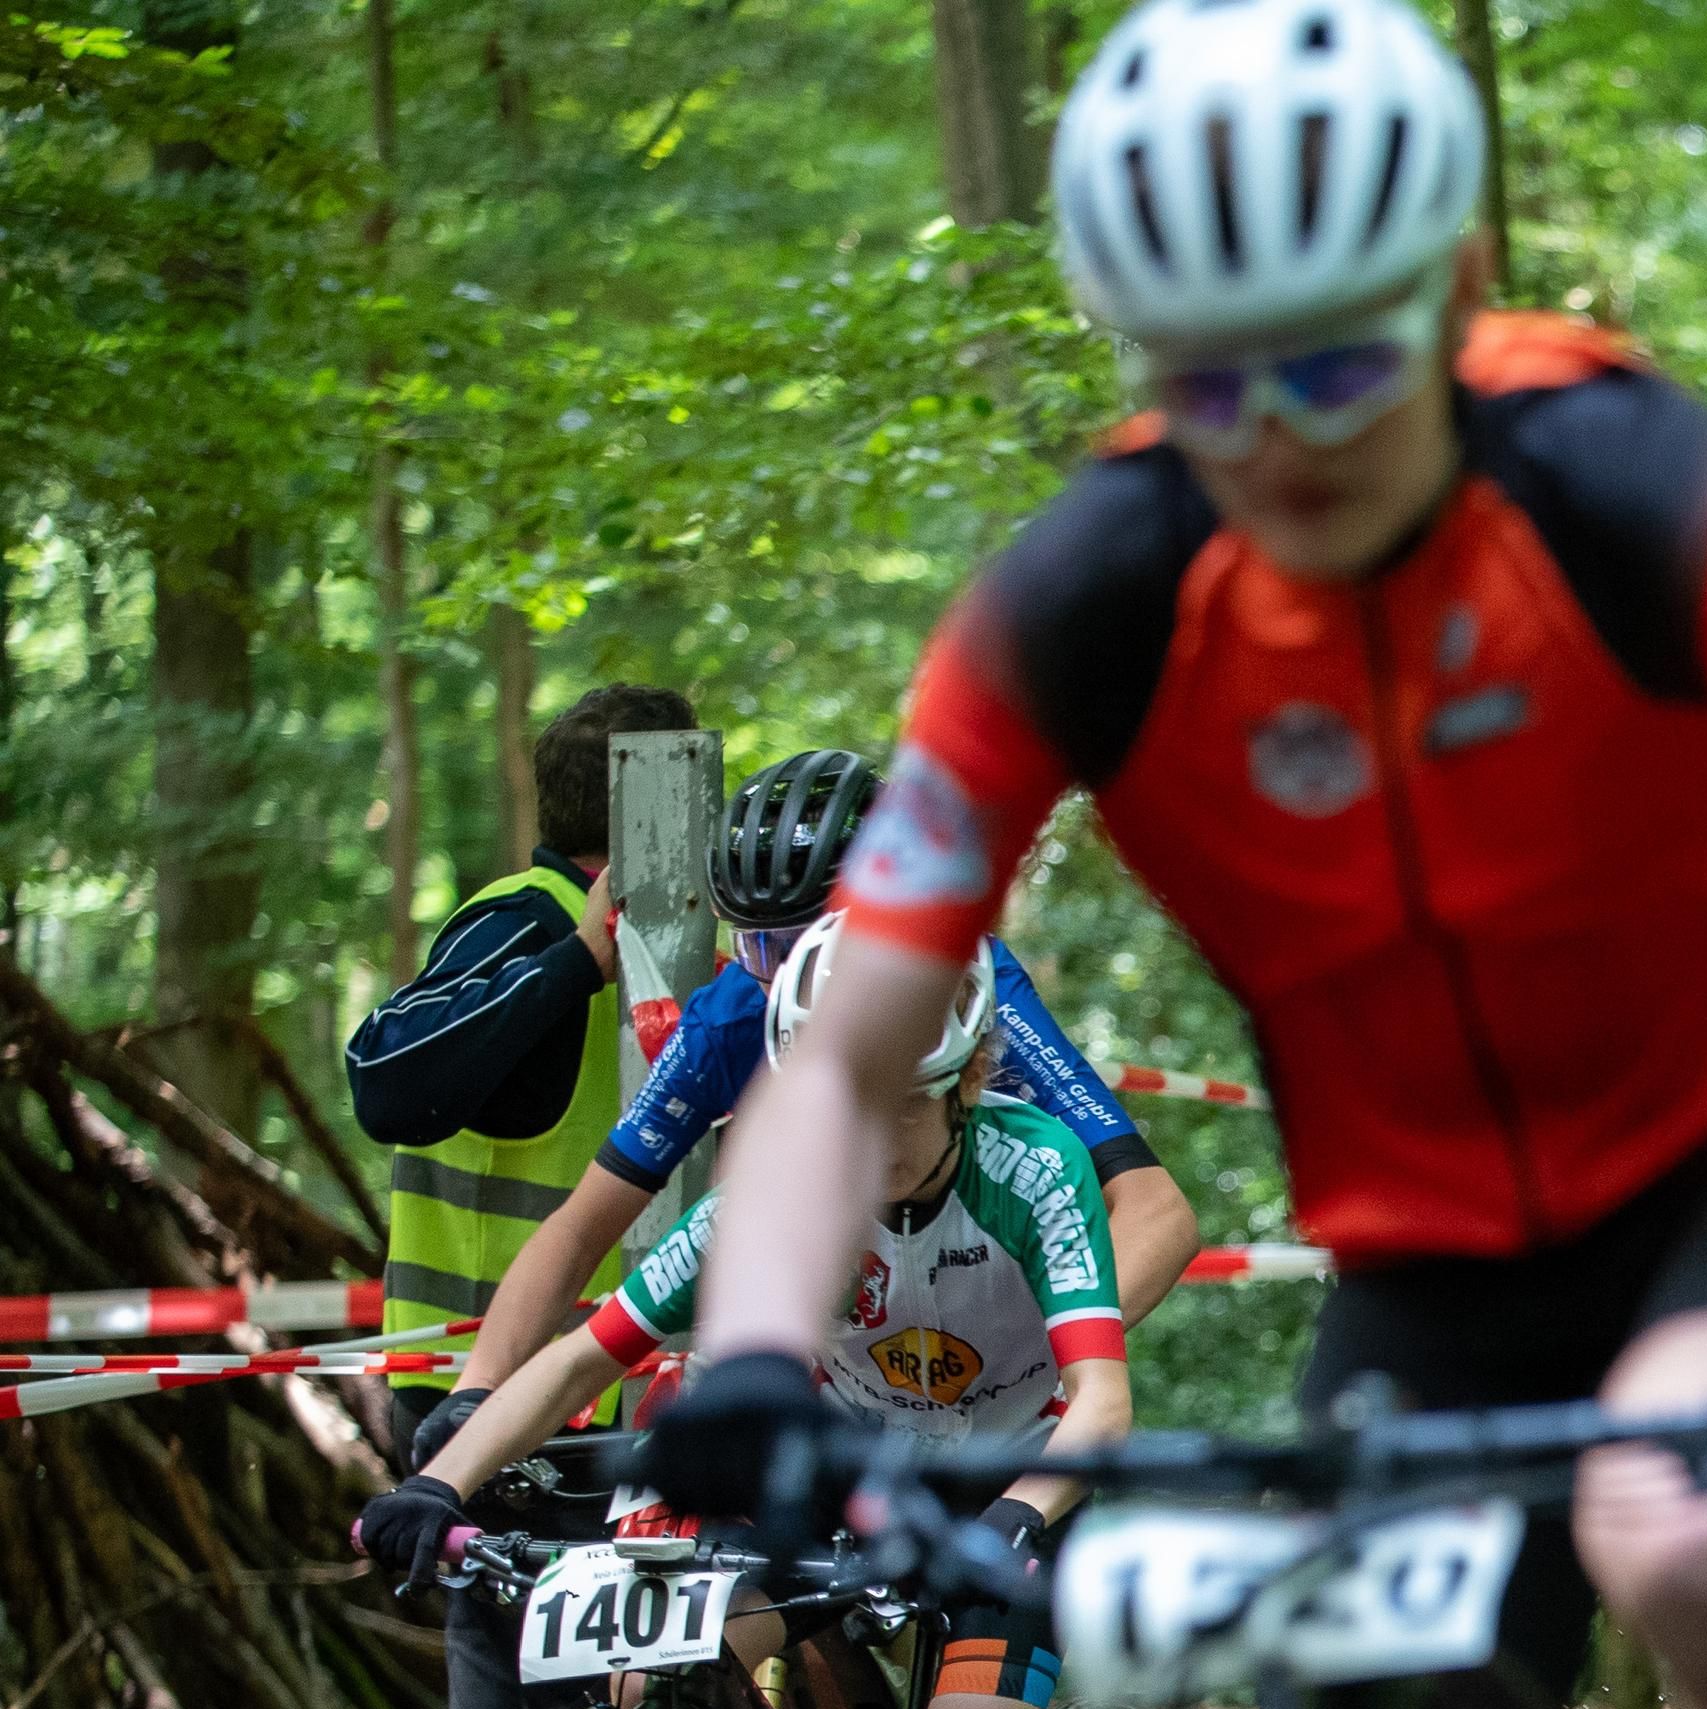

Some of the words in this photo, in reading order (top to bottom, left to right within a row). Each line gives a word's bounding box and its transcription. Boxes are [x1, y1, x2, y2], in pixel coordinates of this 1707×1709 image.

[996, 1003, 1076, 1081] Kamp-EAW
[1069, 1084, 1119, 1126] GmbH
[887, 1349, 966, 1389] ARAG
[536, 1577, 713, 1659] 1401
